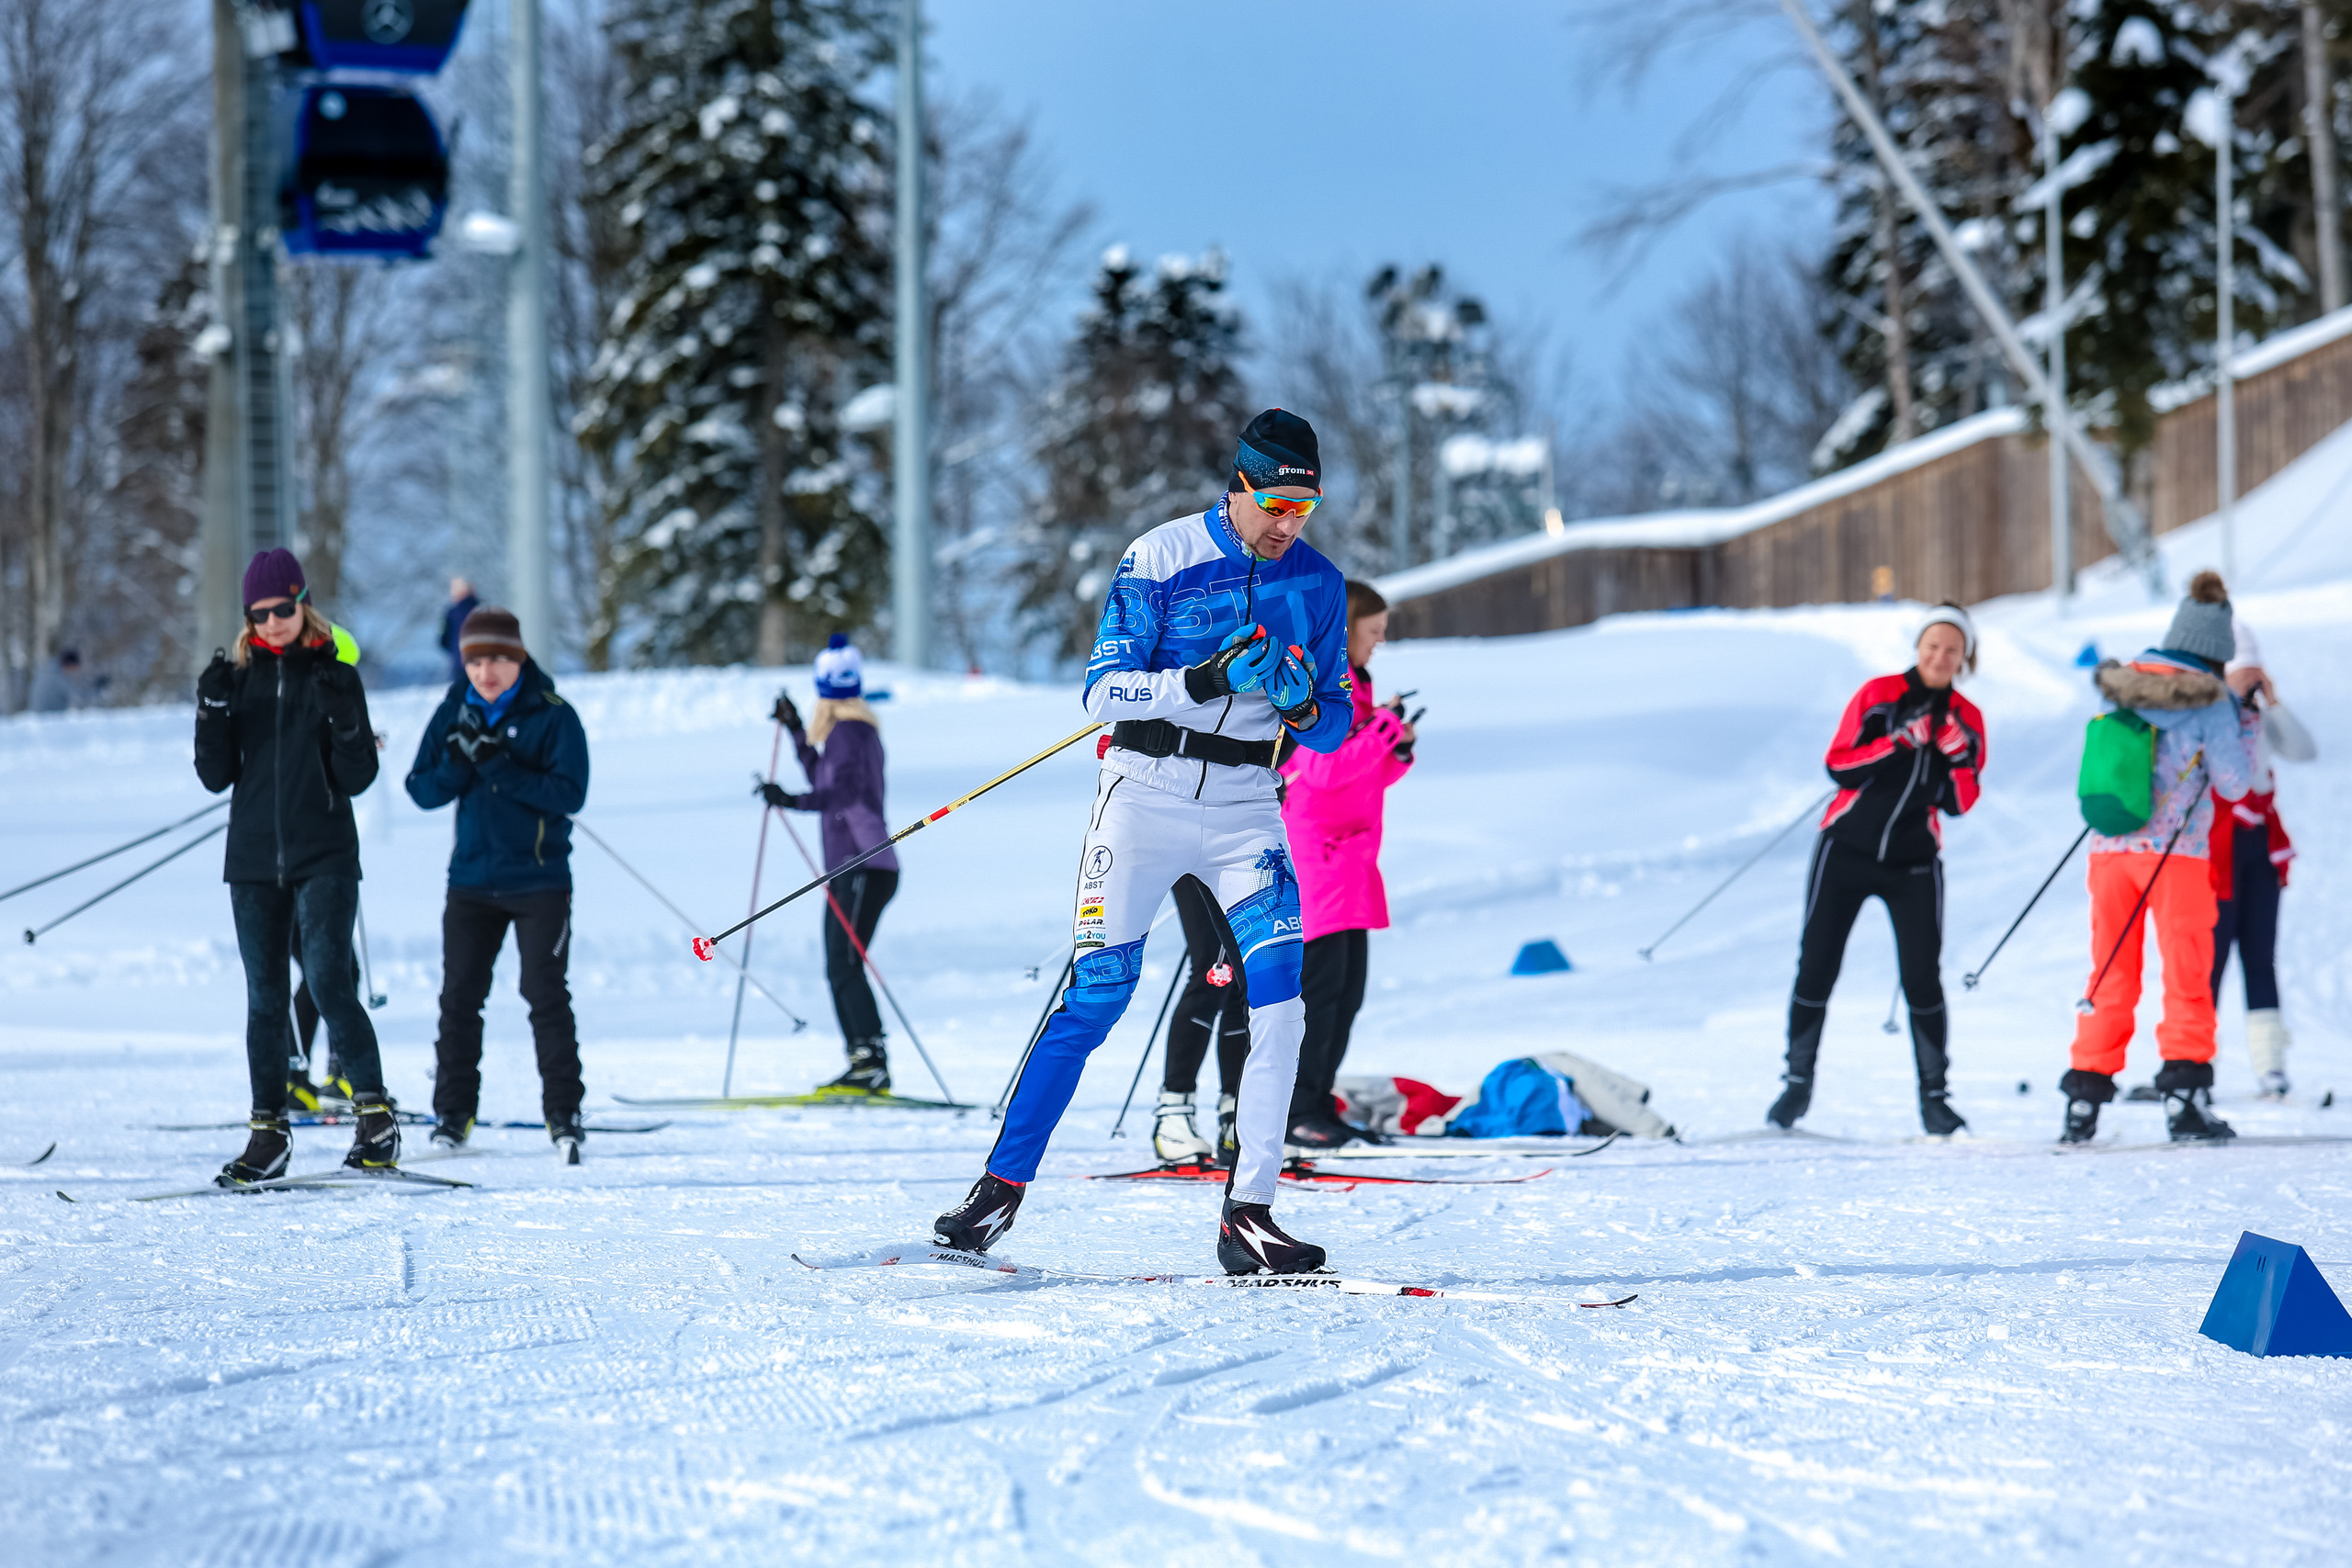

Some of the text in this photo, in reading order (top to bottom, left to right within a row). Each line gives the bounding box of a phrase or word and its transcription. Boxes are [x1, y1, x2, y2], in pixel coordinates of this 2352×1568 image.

[1278, 467, 1306, 476] grom
[1110, 686, 1153, 702] RUS
[1084, 881, 1104, 890] ABST
[1082, 907, 1098, 917] TOKO
